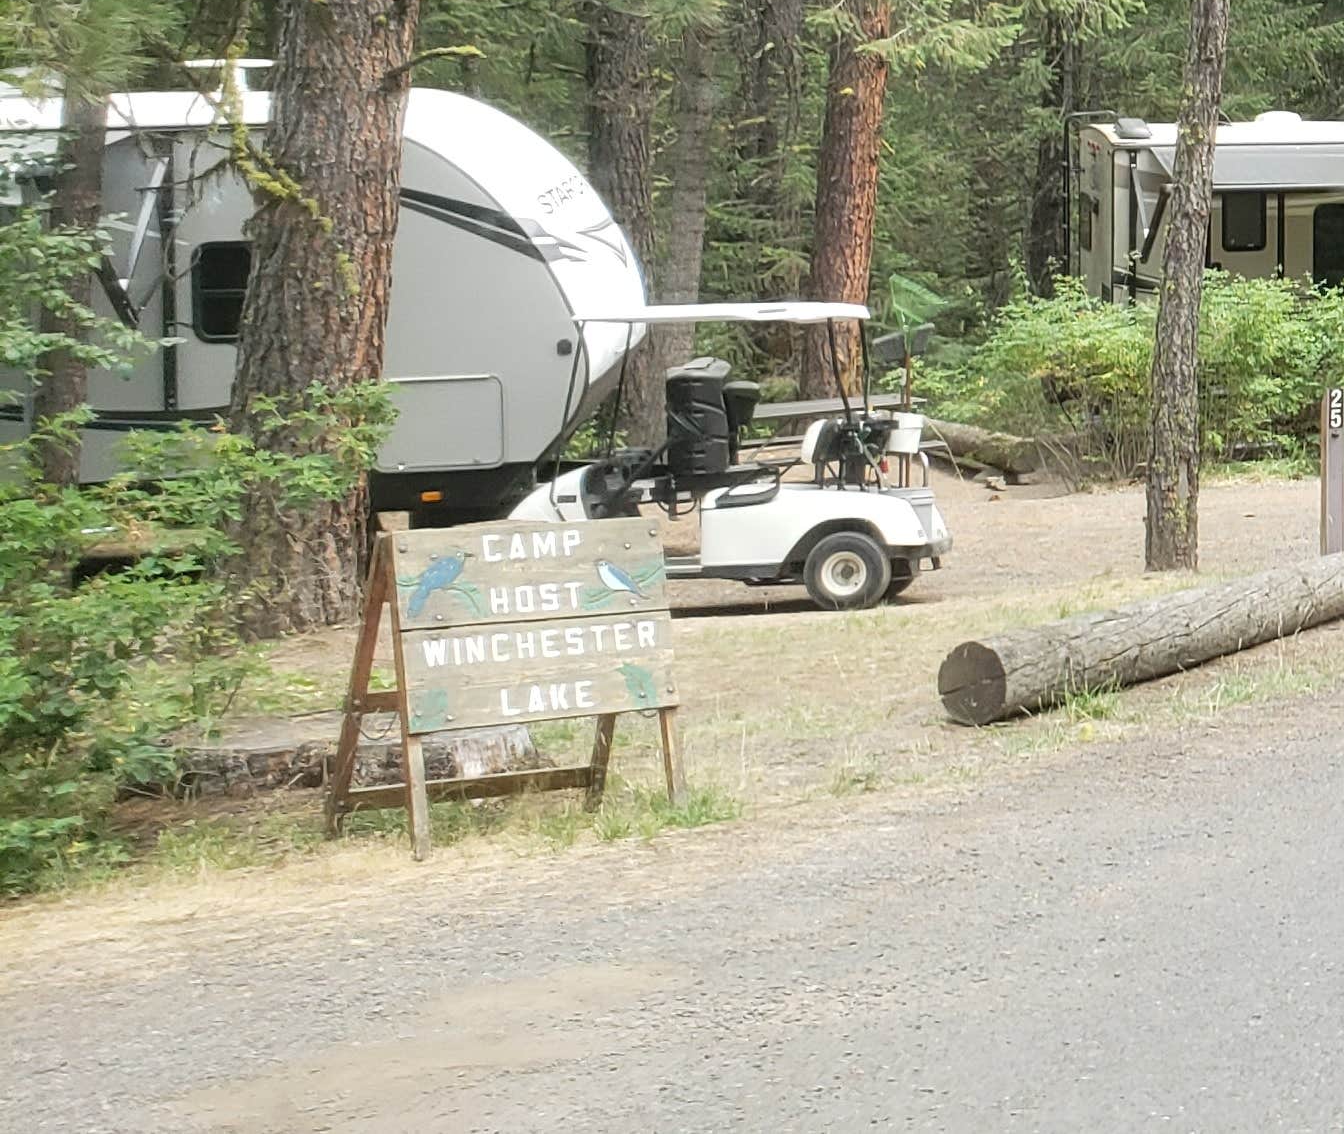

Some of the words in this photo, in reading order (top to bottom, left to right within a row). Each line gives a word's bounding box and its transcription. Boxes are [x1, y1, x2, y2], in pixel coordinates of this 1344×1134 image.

[1330, 388, 1342, 428] 25
[482, 529, 582, 562] CAMP
[490, 581, 584, 614] HOST
[423, 620, 656, 666] WINCHESTER
[500, 680, 595, 716] LAKE
